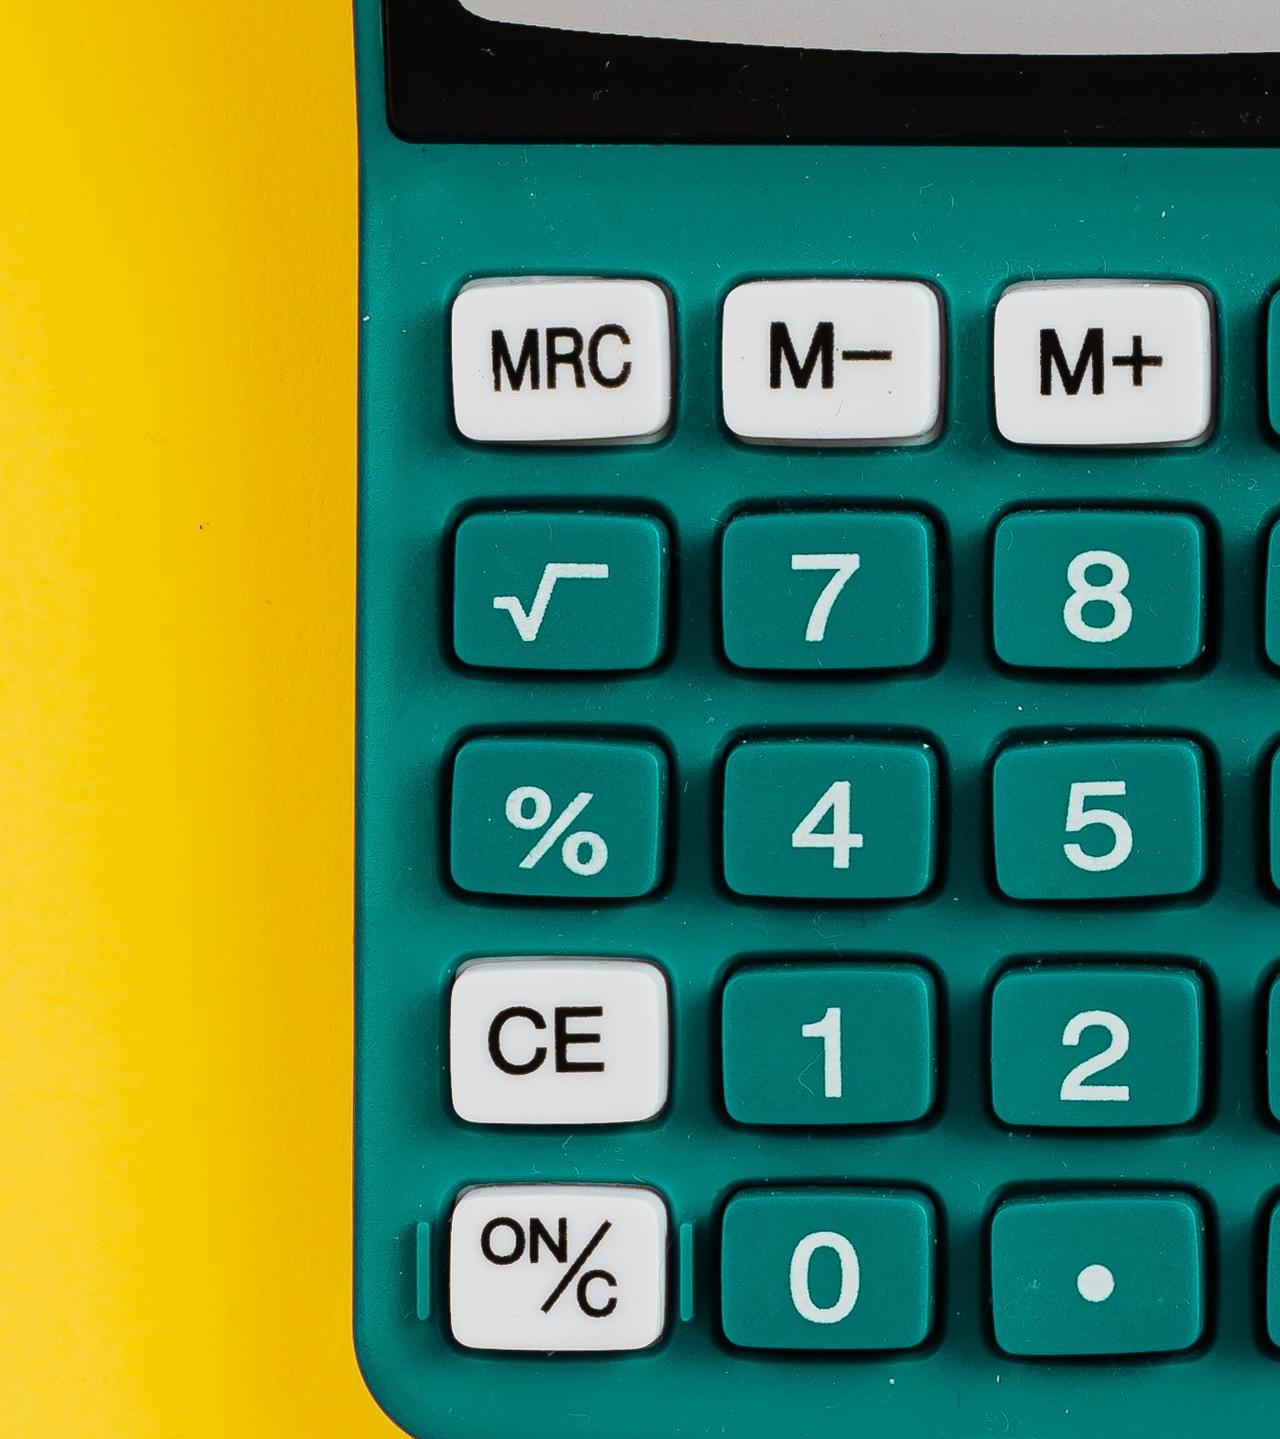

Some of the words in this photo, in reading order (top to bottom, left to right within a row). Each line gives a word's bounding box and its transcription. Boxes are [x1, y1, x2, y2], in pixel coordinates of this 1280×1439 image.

[490, 322, 633, 393] MRC
[1038, 326, 1164, 397] M+
[790, 552, 861, 643] 7
[1062, 549, 1134, 644] 8
[504, 785, 609, 877] %
[791, 779, 864, 870] 4
[1062, 780, 1134, 873] 5
[486, 1004, 606, 1077] CE
[801, 1006, 843, 1099] 1
[1059, 1009, 1131, 1102] 2
[788, 1230, 861, 1325] 0
